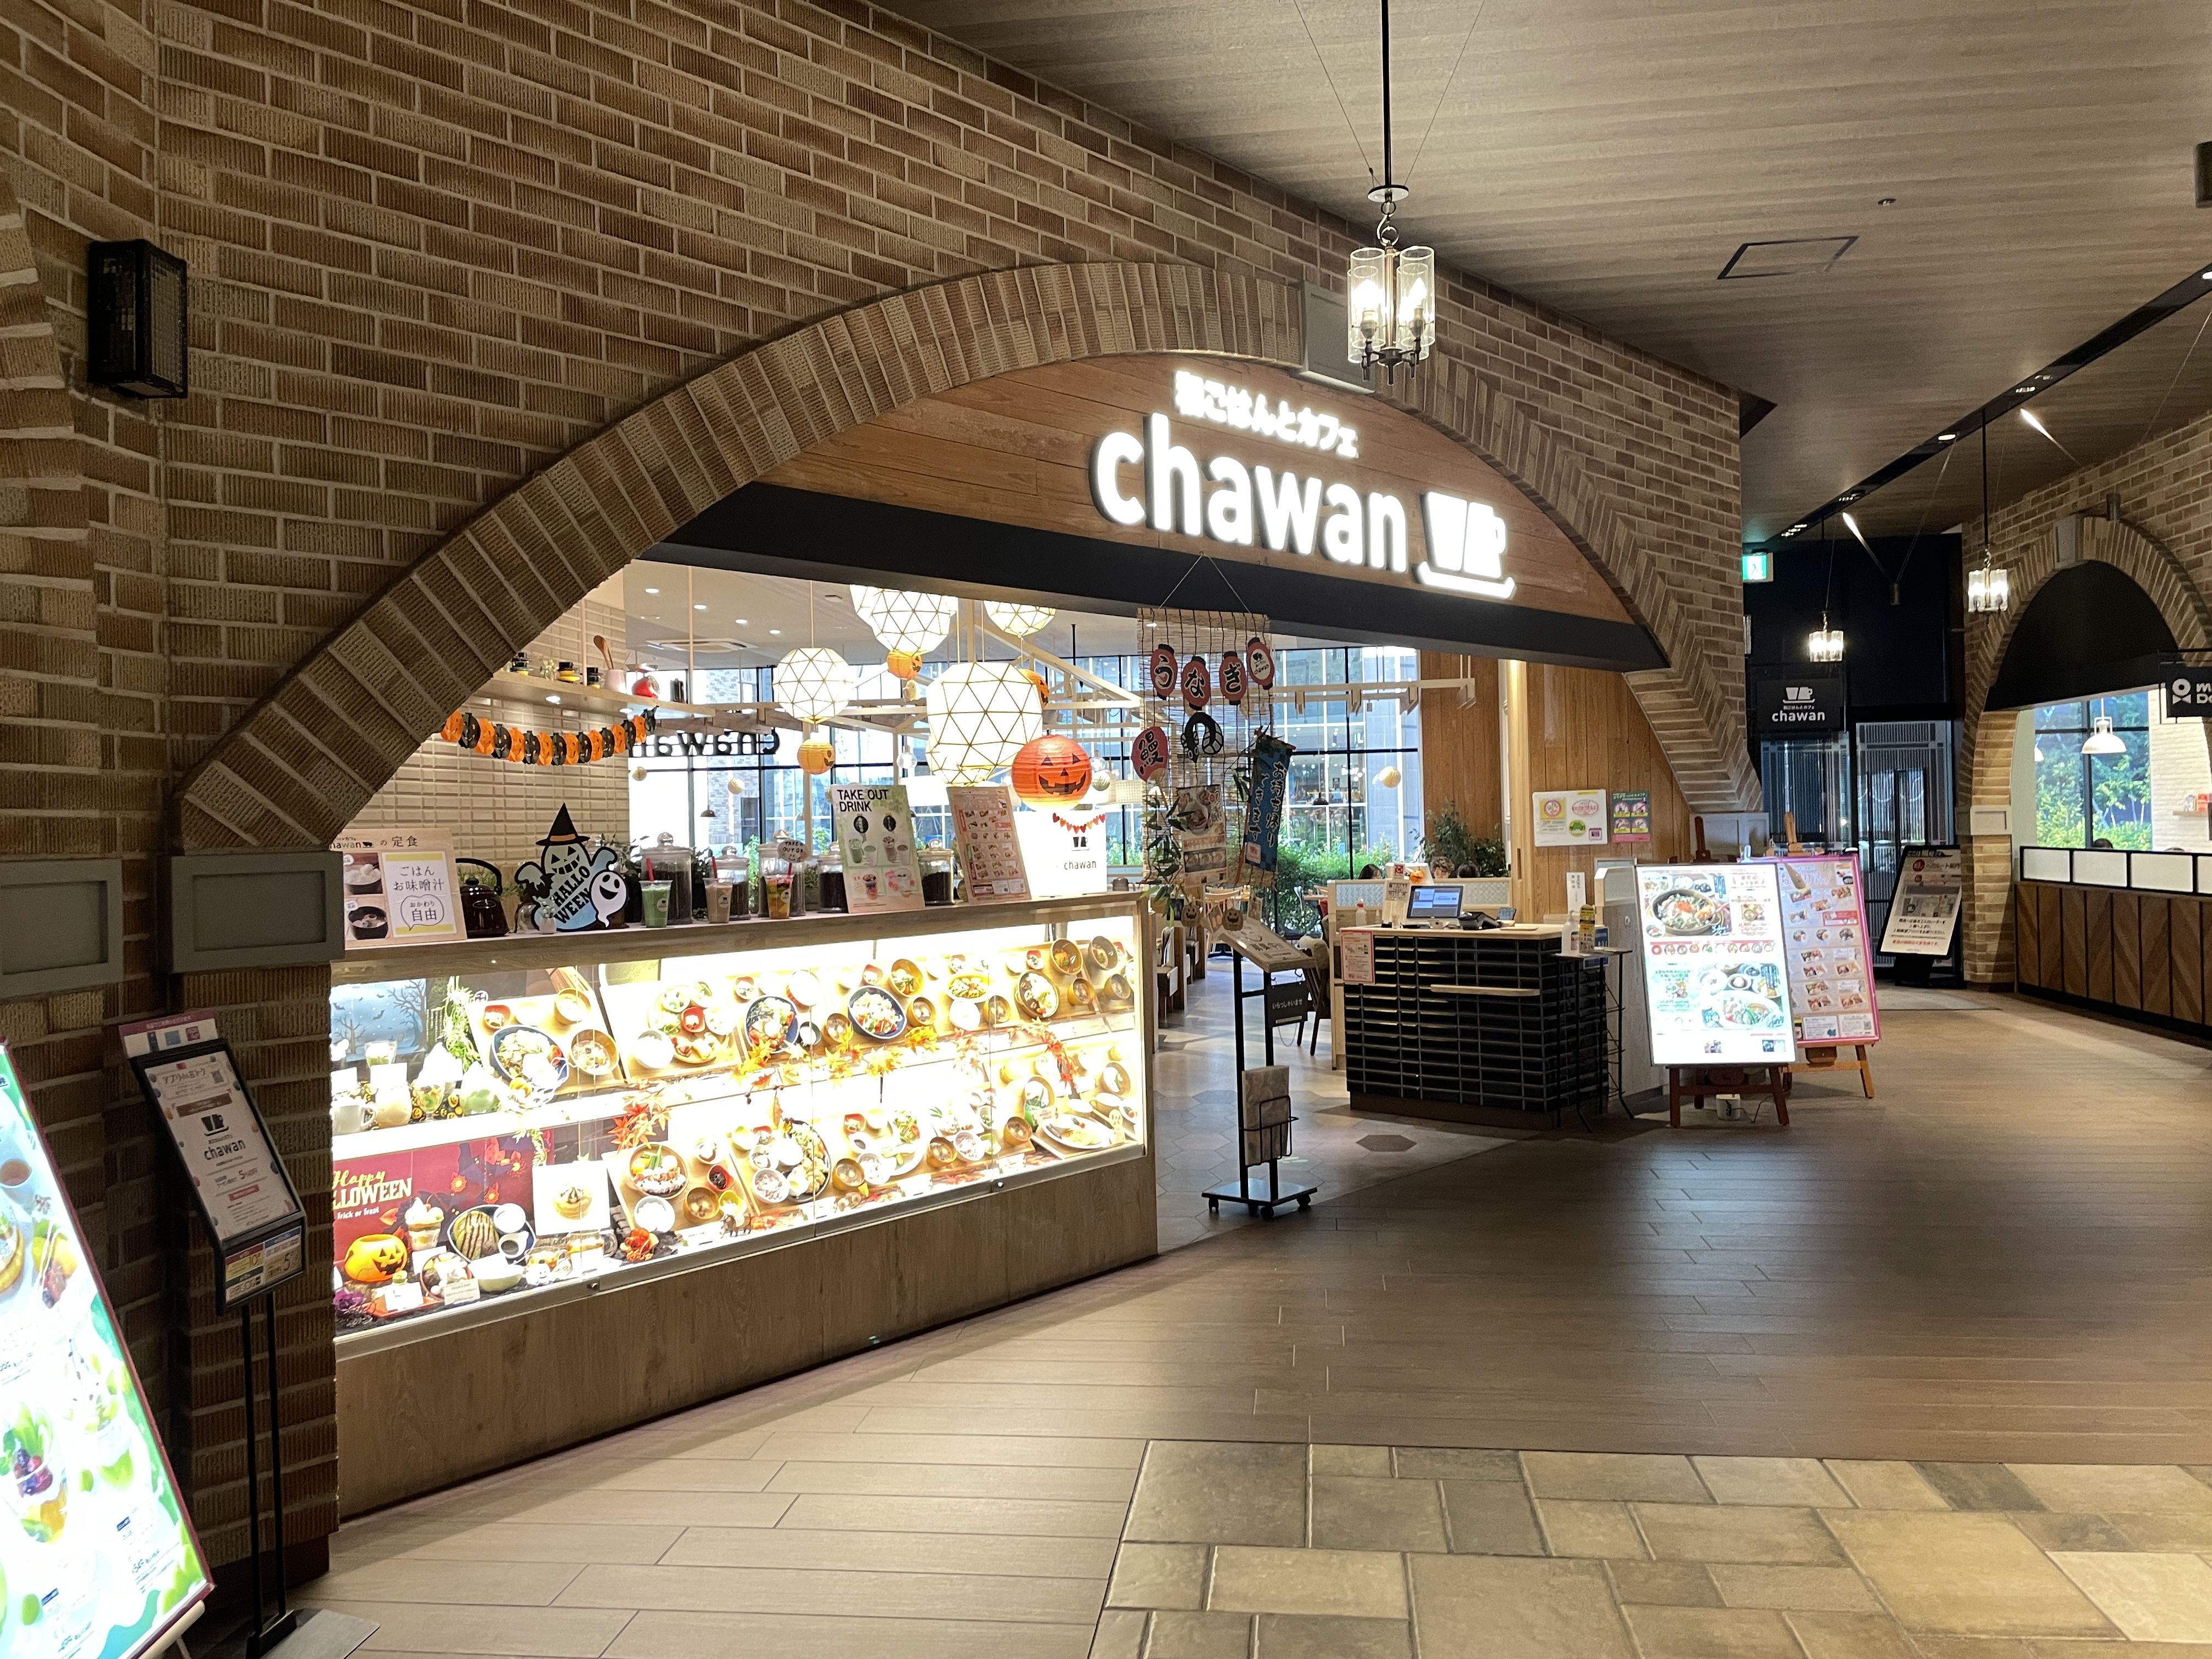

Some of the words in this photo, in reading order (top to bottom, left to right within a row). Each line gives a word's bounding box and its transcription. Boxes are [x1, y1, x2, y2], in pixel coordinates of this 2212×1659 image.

[1095, 413, 1408, 573] chawan
[1772, 710, 1825, 722] chawan
[837, 789, 864, 800] TAKE
[867, 789, 889, 800] OUT
[839, 801, 872, 812] DRINK
[1266, 761, 1286, 848] お持ち帰り
[400, 866, 435, 877] ごはん
[1064, 860, 1097, 870] chawan
[393, 878, 444, 891] お味噌汁
[412, 907, 437, 922] 自由
[204, 1139, 246, 1160] chawan
[332, 1170, 386, 1189] Happy
[332, 1177, 412, 1210] LLOWEEN
[337, 1210, 353, 1220] Trick
